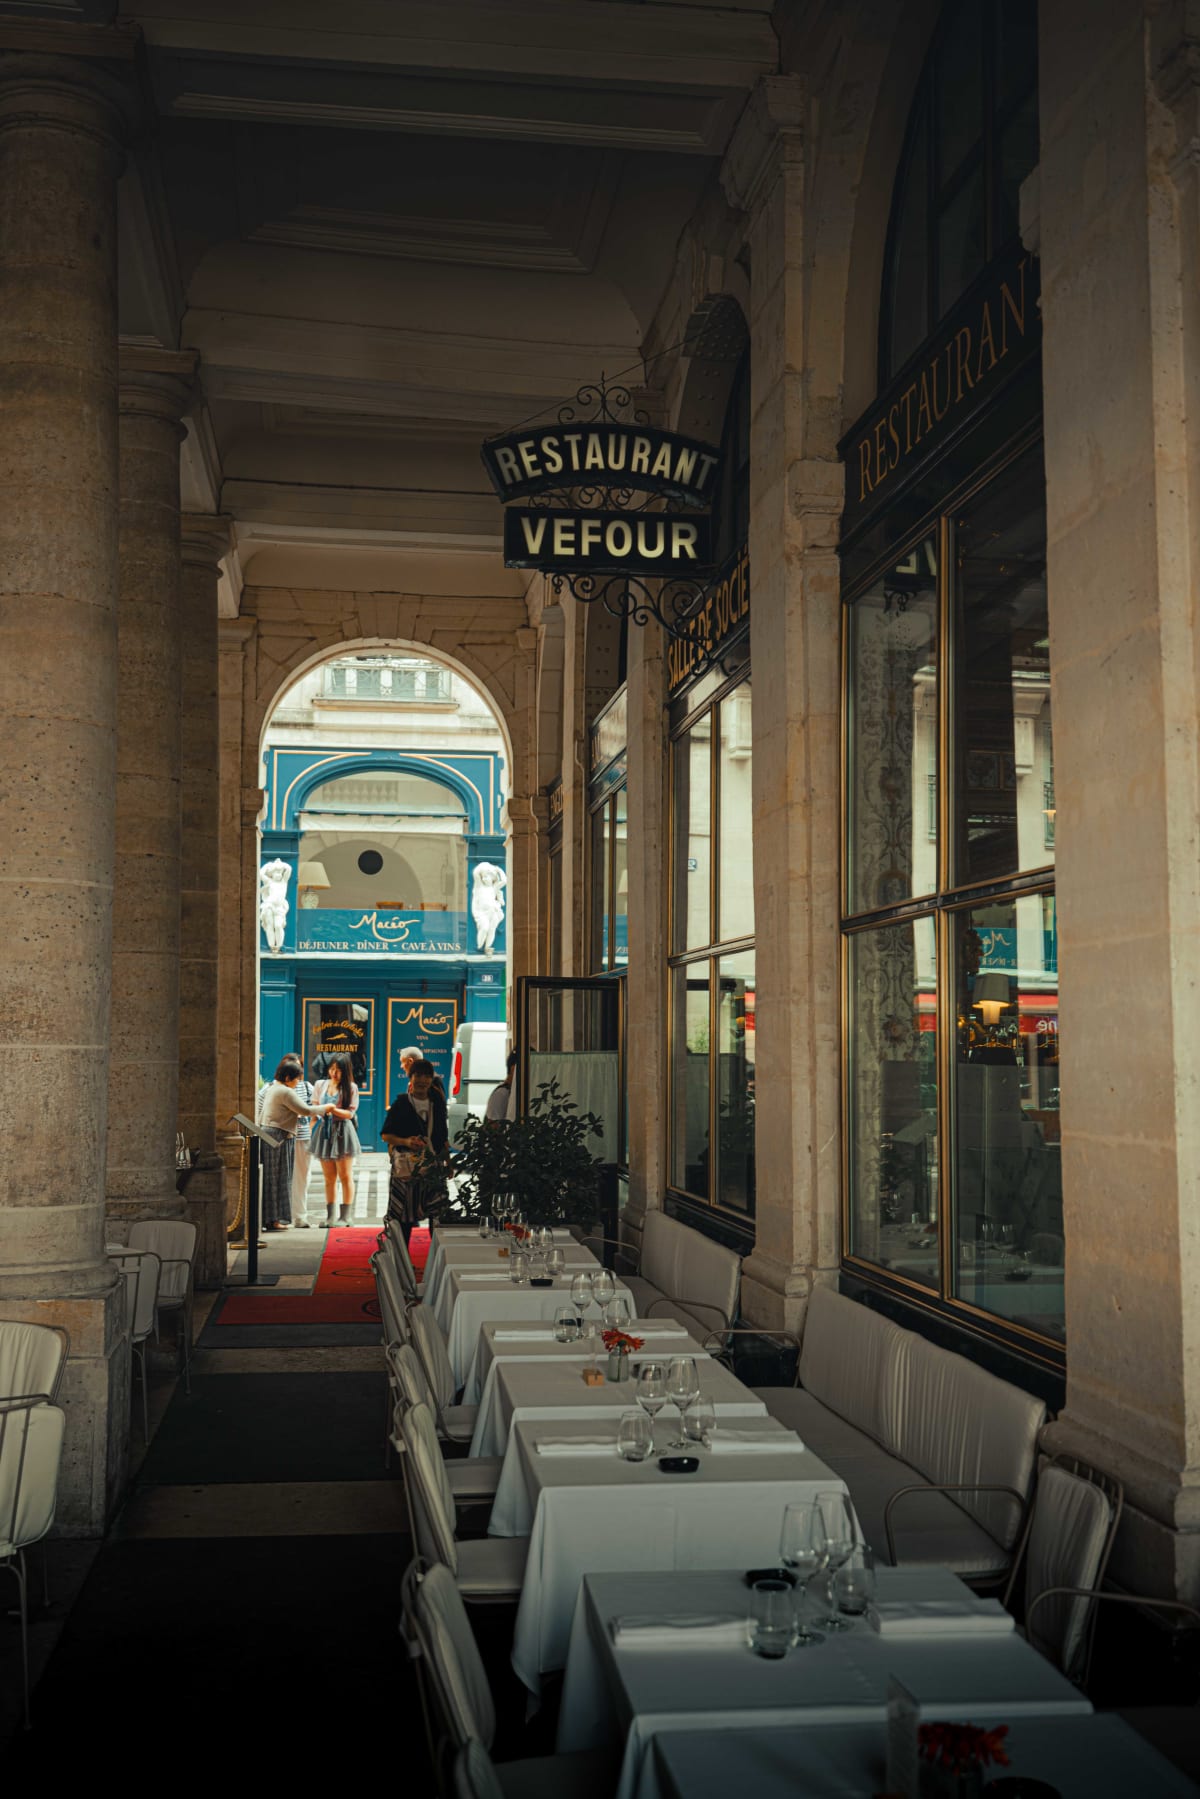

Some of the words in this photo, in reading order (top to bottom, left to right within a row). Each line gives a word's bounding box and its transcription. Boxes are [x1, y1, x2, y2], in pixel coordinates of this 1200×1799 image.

[858, 256, 1041, 503] RESTAURAN
[494, 433, 719, 490] RESTAURANT
[520, 516, 698, 559] VEFOUR
[401, 942, 427, 951] CAVE
[436, 942, 461, 951] VINS
[316, 1043, 359, 1053] RESTAURANT
